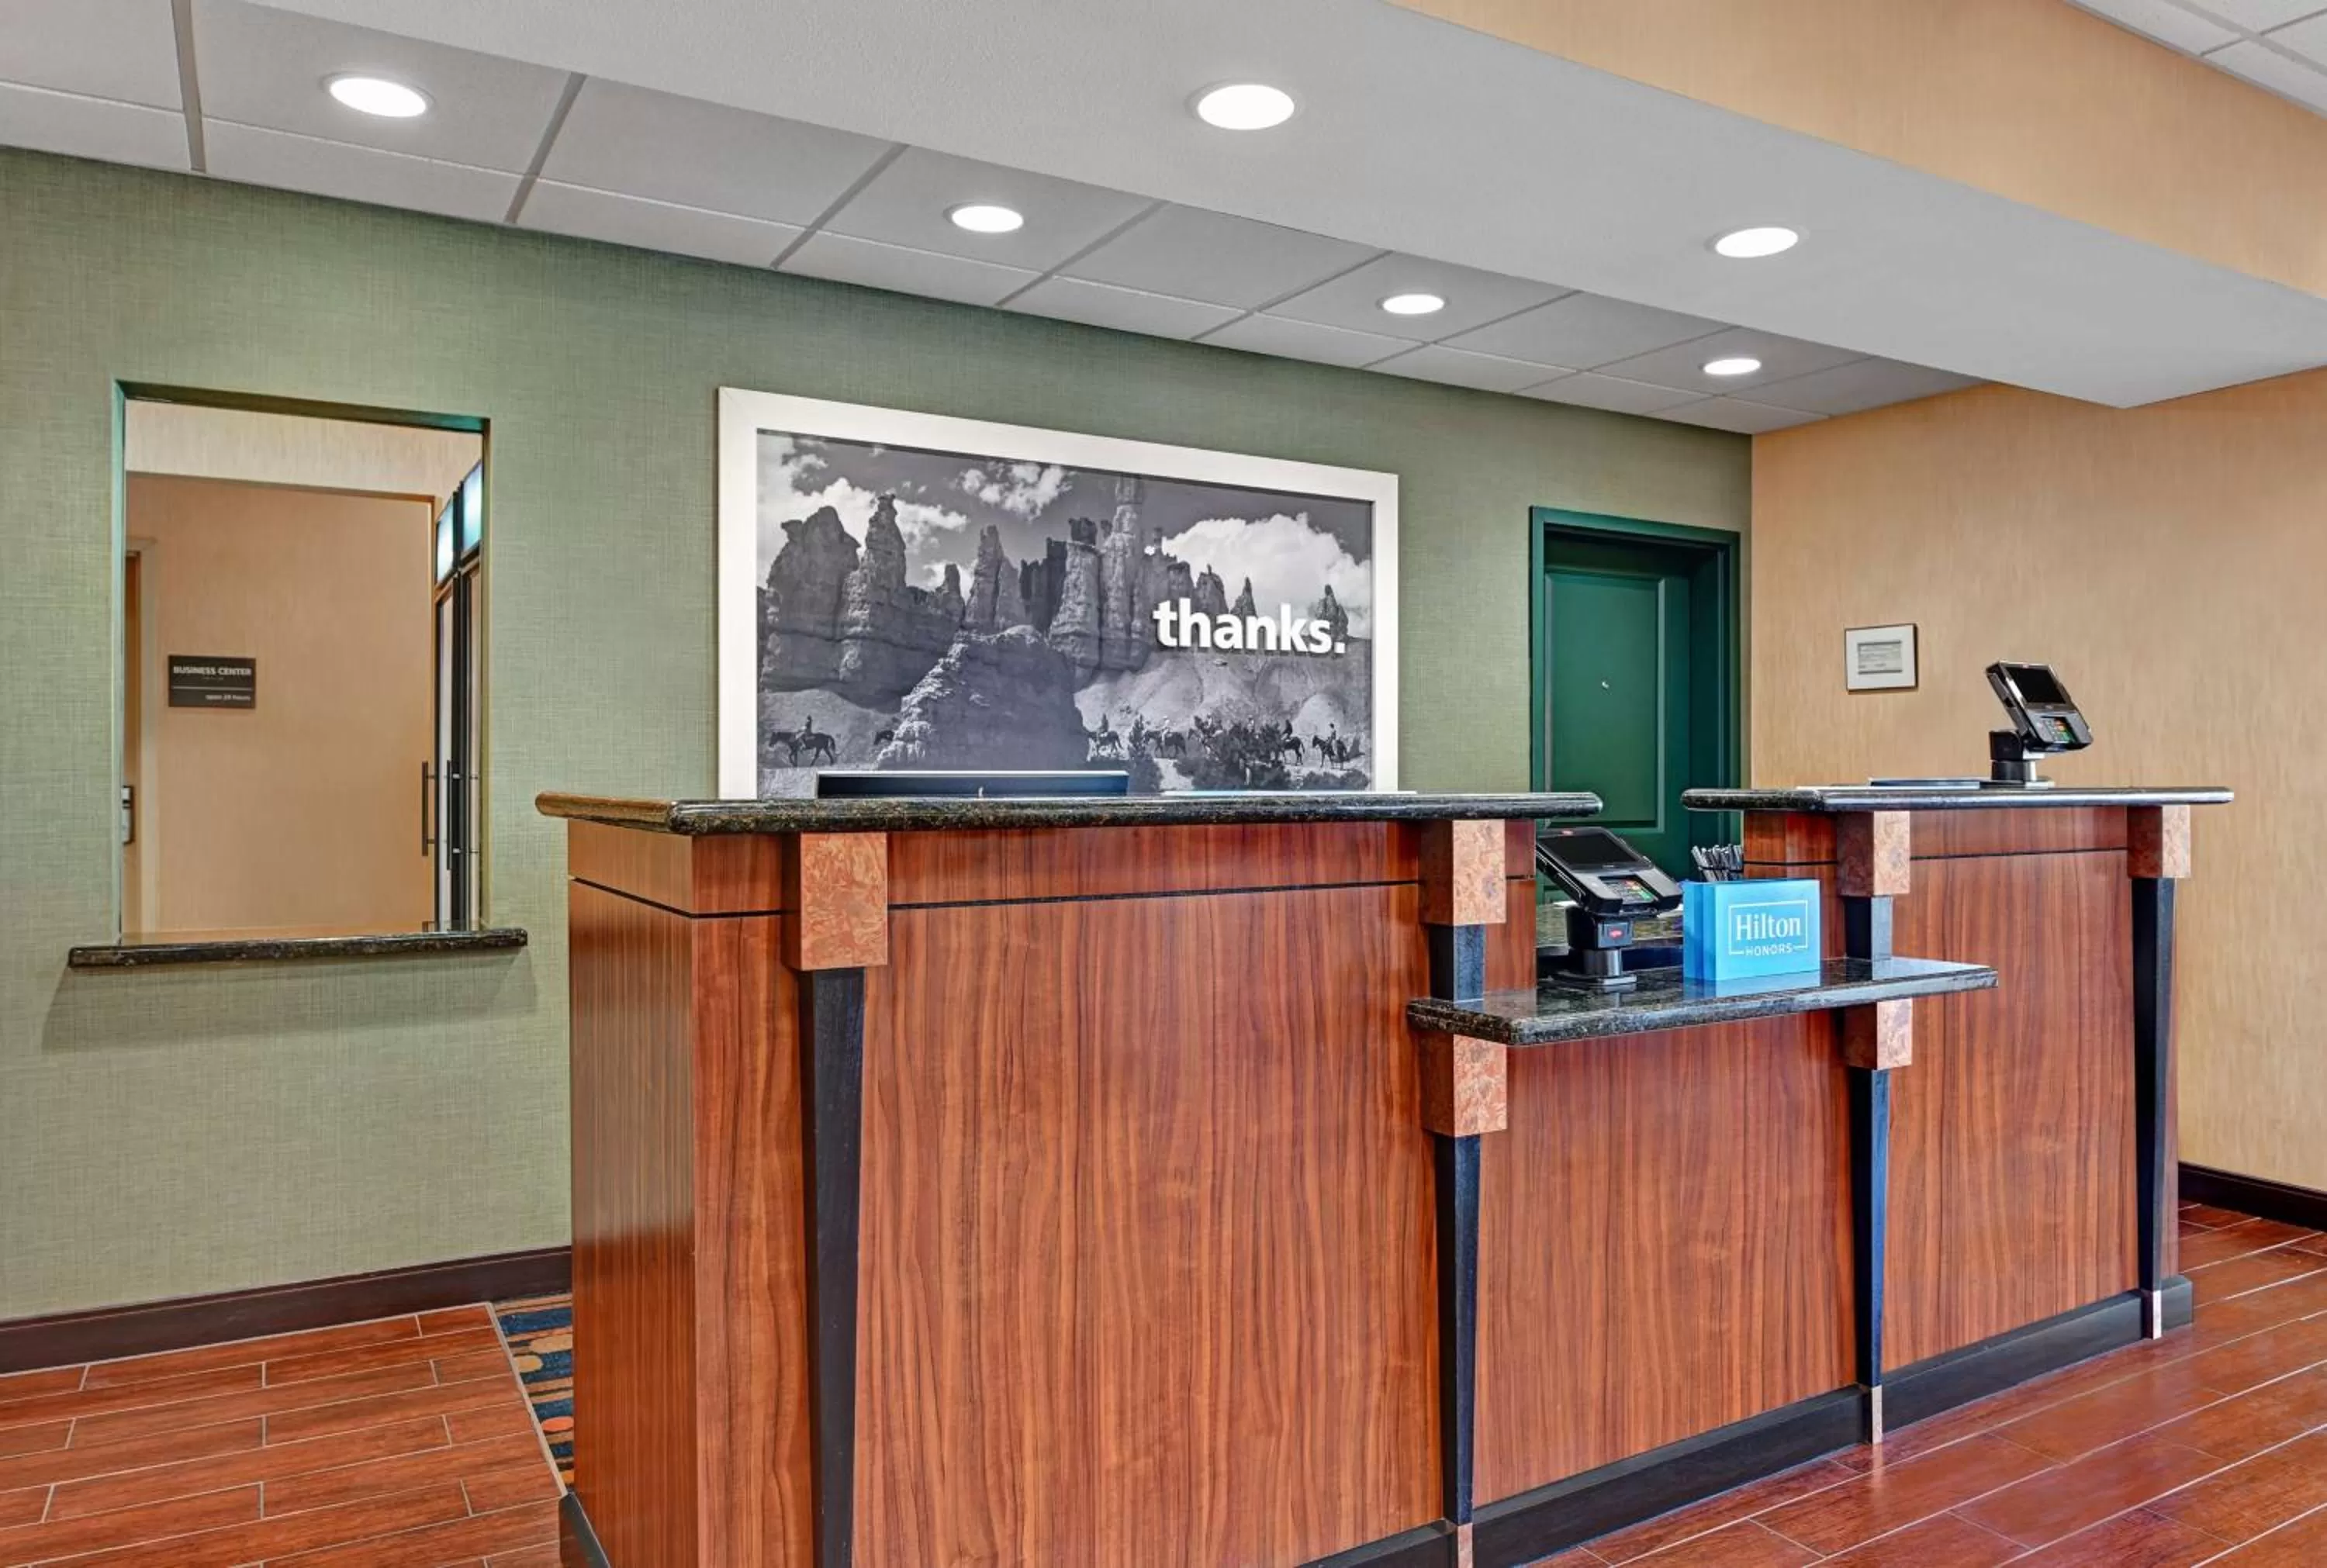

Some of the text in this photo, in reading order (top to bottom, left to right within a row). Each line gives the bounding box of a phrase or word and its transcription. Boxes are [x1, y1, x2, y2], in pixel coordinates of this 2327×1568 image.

[1152, 597, 1346, 654] thanks.
[173, 665, 252, 675] BUSINESS CENTER
[1736, 913, 1801, 941] Hilton
[1745, 942, 1793, 956] HONORS
